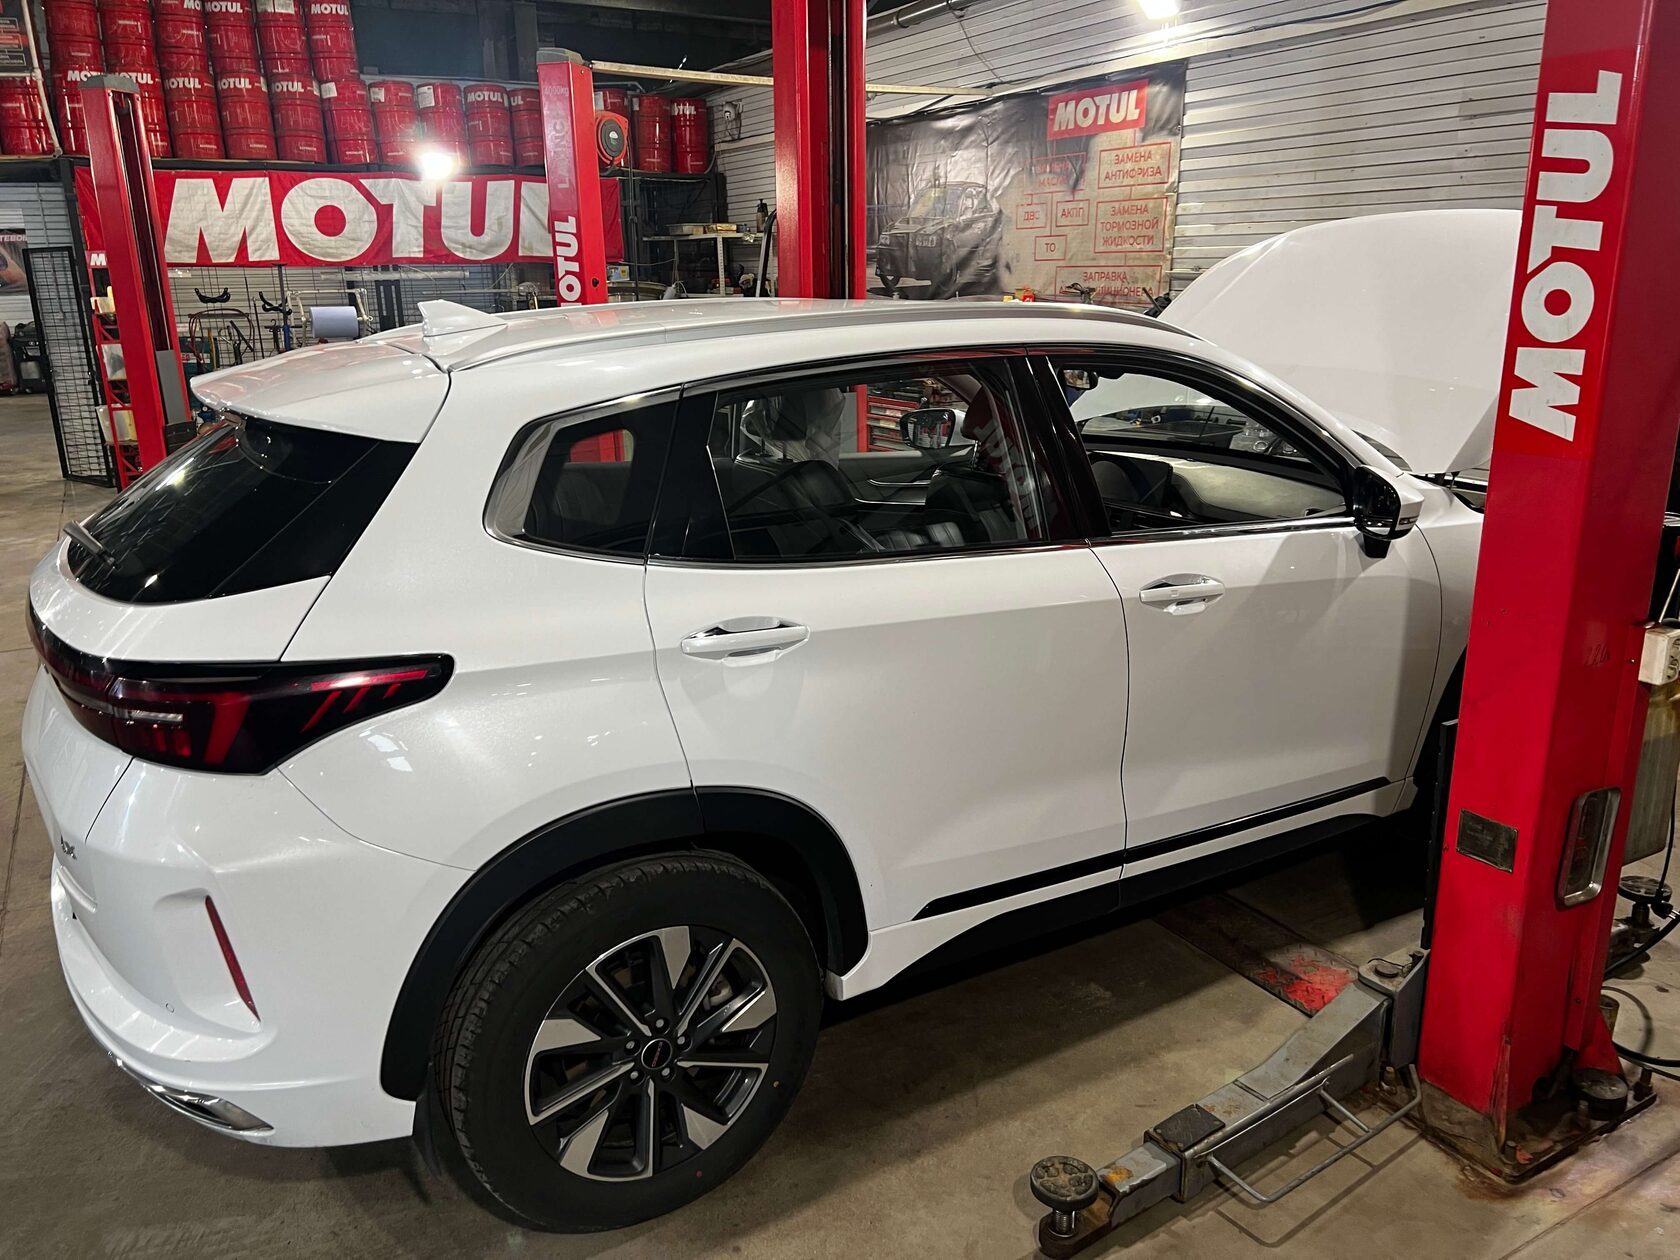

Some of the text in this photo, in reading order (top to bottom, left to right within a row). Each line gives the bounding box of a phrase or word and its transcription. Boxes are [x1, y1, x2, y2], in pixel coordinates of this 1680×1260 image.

[311, 4, 349, 15] MOTUL
[467, 91, 503, 103] MOTUL
[1053, 89, 1140, 131] MOTUL
[1114, 150, 1153, 165] ЗАМЕНА
[1104, 166, 1162, 181] АНТИФРИЗА
[1024, 211, 1040, 222] ДВС
[1061, 207, 1084, 219] АКПП
[1111, 204, 1149, 217] ЗАМЕНА
[165, 177, 552, 263] MOTUL
[1100, 217, 1159, 231] ТОРМОЗНОЙ
[1044, 242, 1056, 253] ТО
[1102, 235, 1154, 247] ЖИДКОСТИ
[554, 216, 582, 307] OTUL
[1509, 69, 1623, 442] MOTUL
[1083, 271, 1129, 283] ЗАПРАВКА
